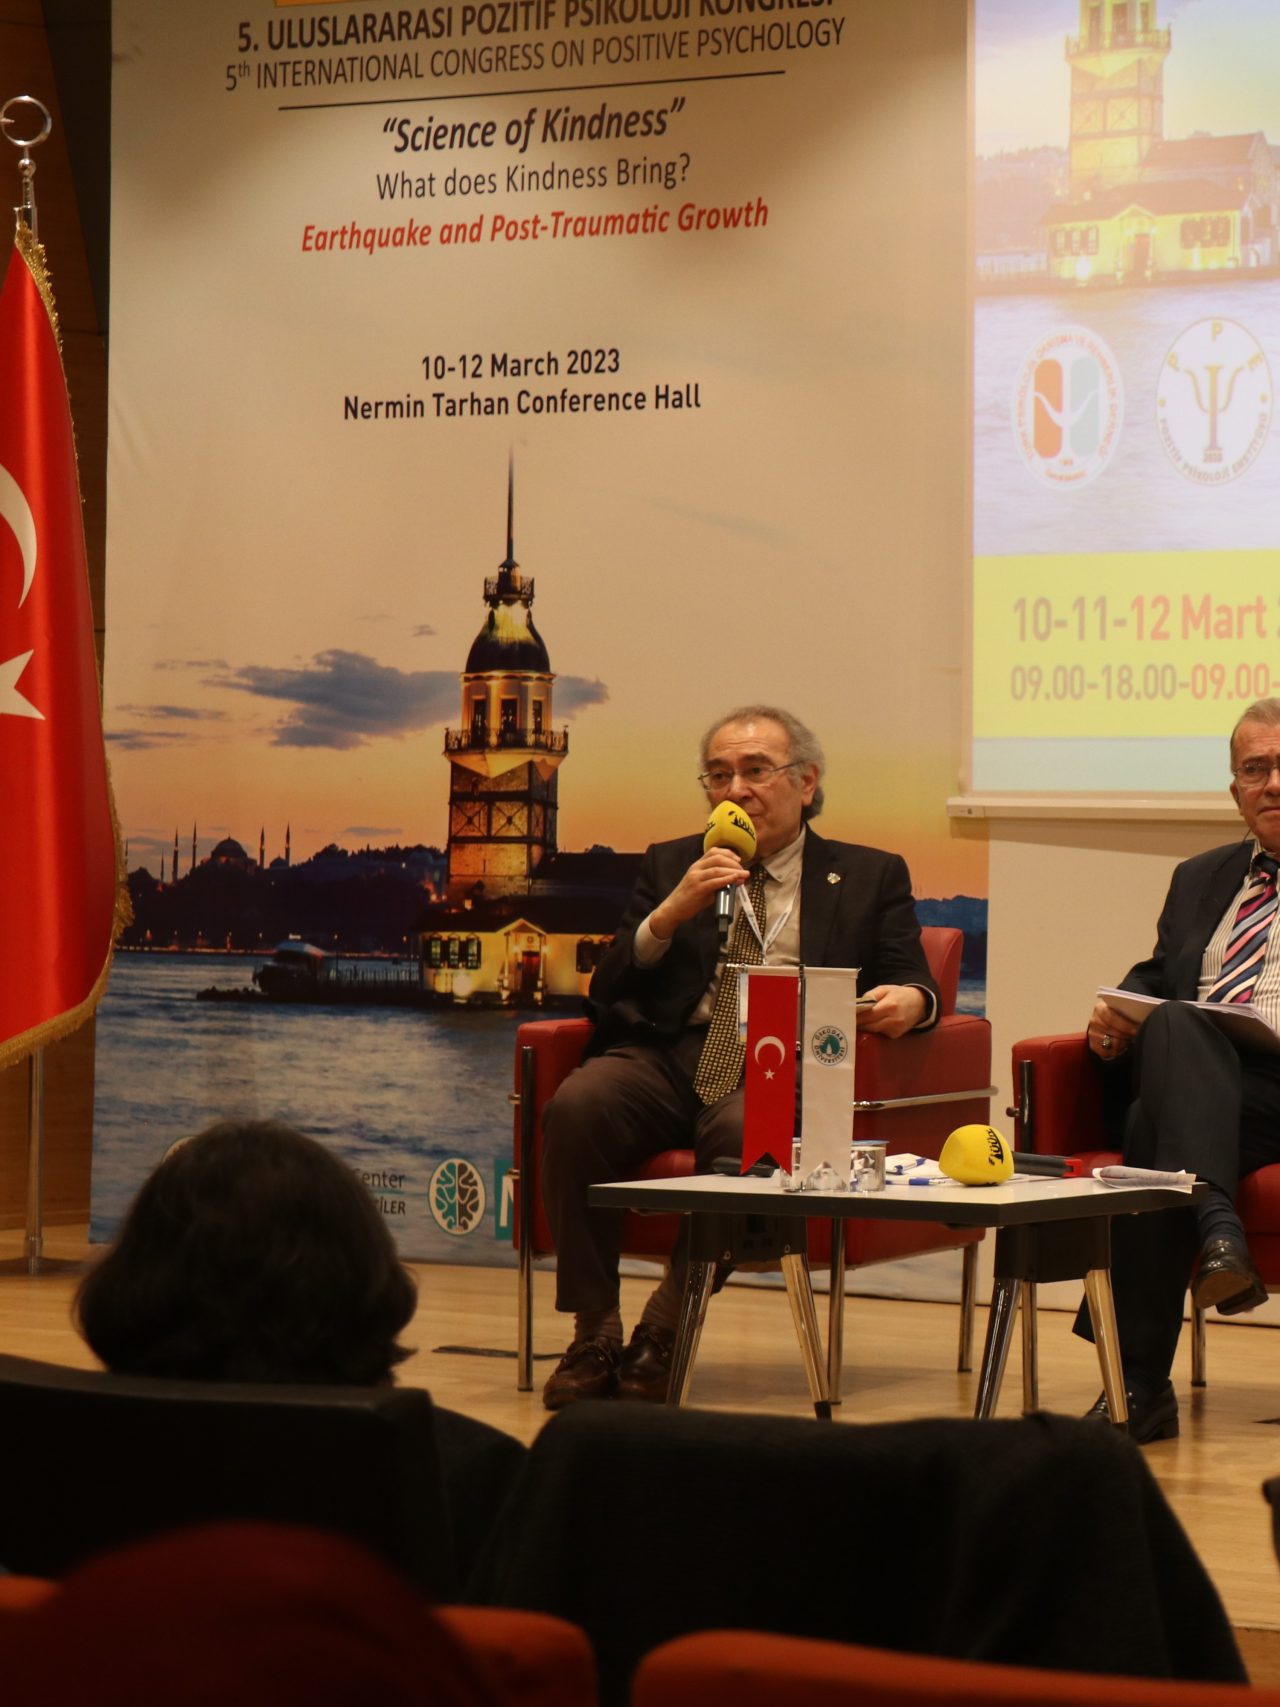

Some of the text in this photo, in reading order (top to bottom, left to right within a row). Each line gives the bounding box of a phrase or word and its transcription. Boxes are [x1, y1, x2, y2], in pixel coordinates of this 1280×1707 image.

[238, 21, 259, 52] 5.
[267, 7, 453, 50] ULUSLARARASI
[225, 17, 846, 91] 5th INTERNATIONAL CONGRESS ON POSITIVE PSYCHOLOGY
[504, 107, 538, 154] of
[376, 152, 691, 200] What does Kindness Bring?
[301, 196, 769, 256] Earthquake and Post-Traumatic Growth
[421, 347, 620, 380] 10-12 March 2023
[344, 383, 702, 420] Nermin Tarhan Conference Hall
[1013, 595, 1171, 642] 10-11-12
[1180, 594, 1268, 640] Mart
[354, 1167, 406, 1188] enter
